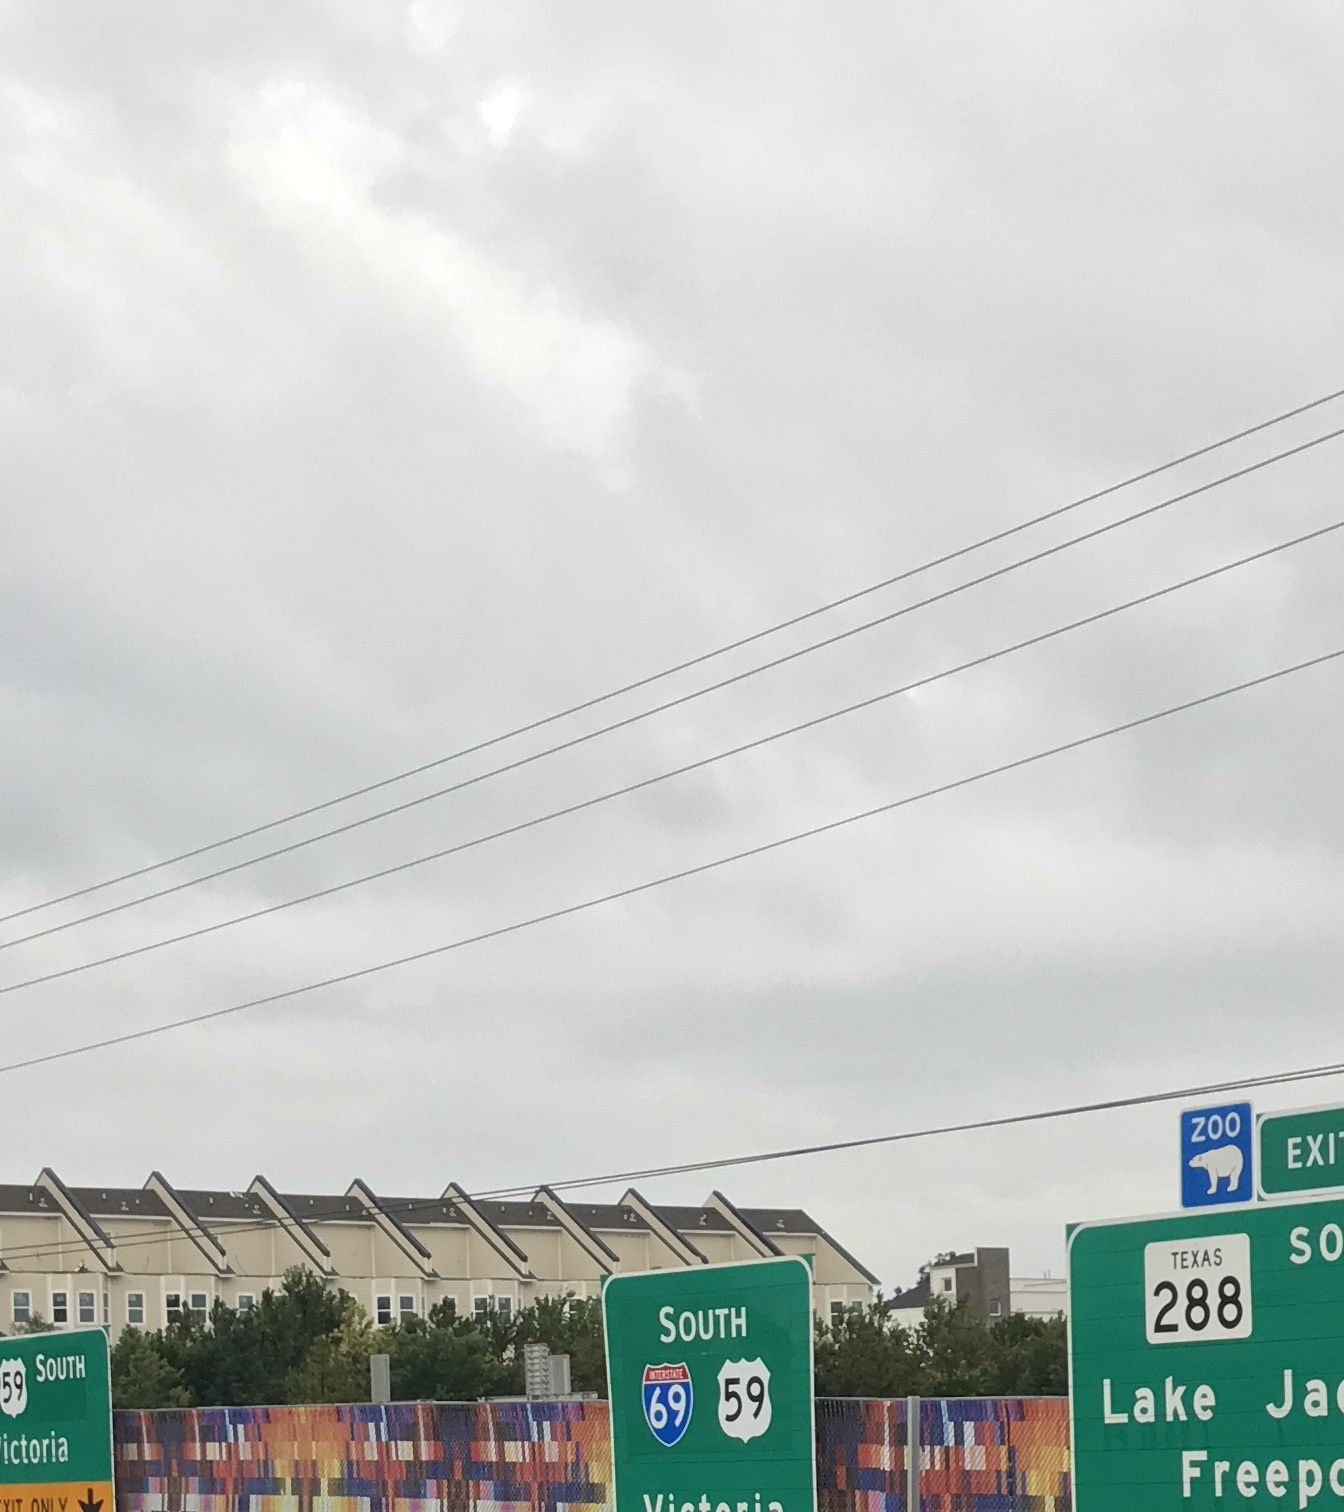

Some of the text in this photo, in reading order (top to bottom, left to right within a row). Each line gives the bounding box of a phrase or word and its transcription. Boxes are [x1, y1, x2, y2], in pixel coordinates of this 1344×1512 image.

[1190, 1111, 1241, 1144] ZOO
[1170, 1248, 1223, 1271] TEXAS
[1153, 1275, 1244, 1334] 288
[659, 1305, 747, 1344] SOUTH
[36, 1353, 86, 1383] SOUTH
[649, 1368, 684, 1380] INTERSTATE
[2, 1370, 23, 1404] 59
[724, 1375, 765, 1423] 59
[1103, 1375, 1216, 1425] Lake
[649, 1384, 687, 1430] 69
